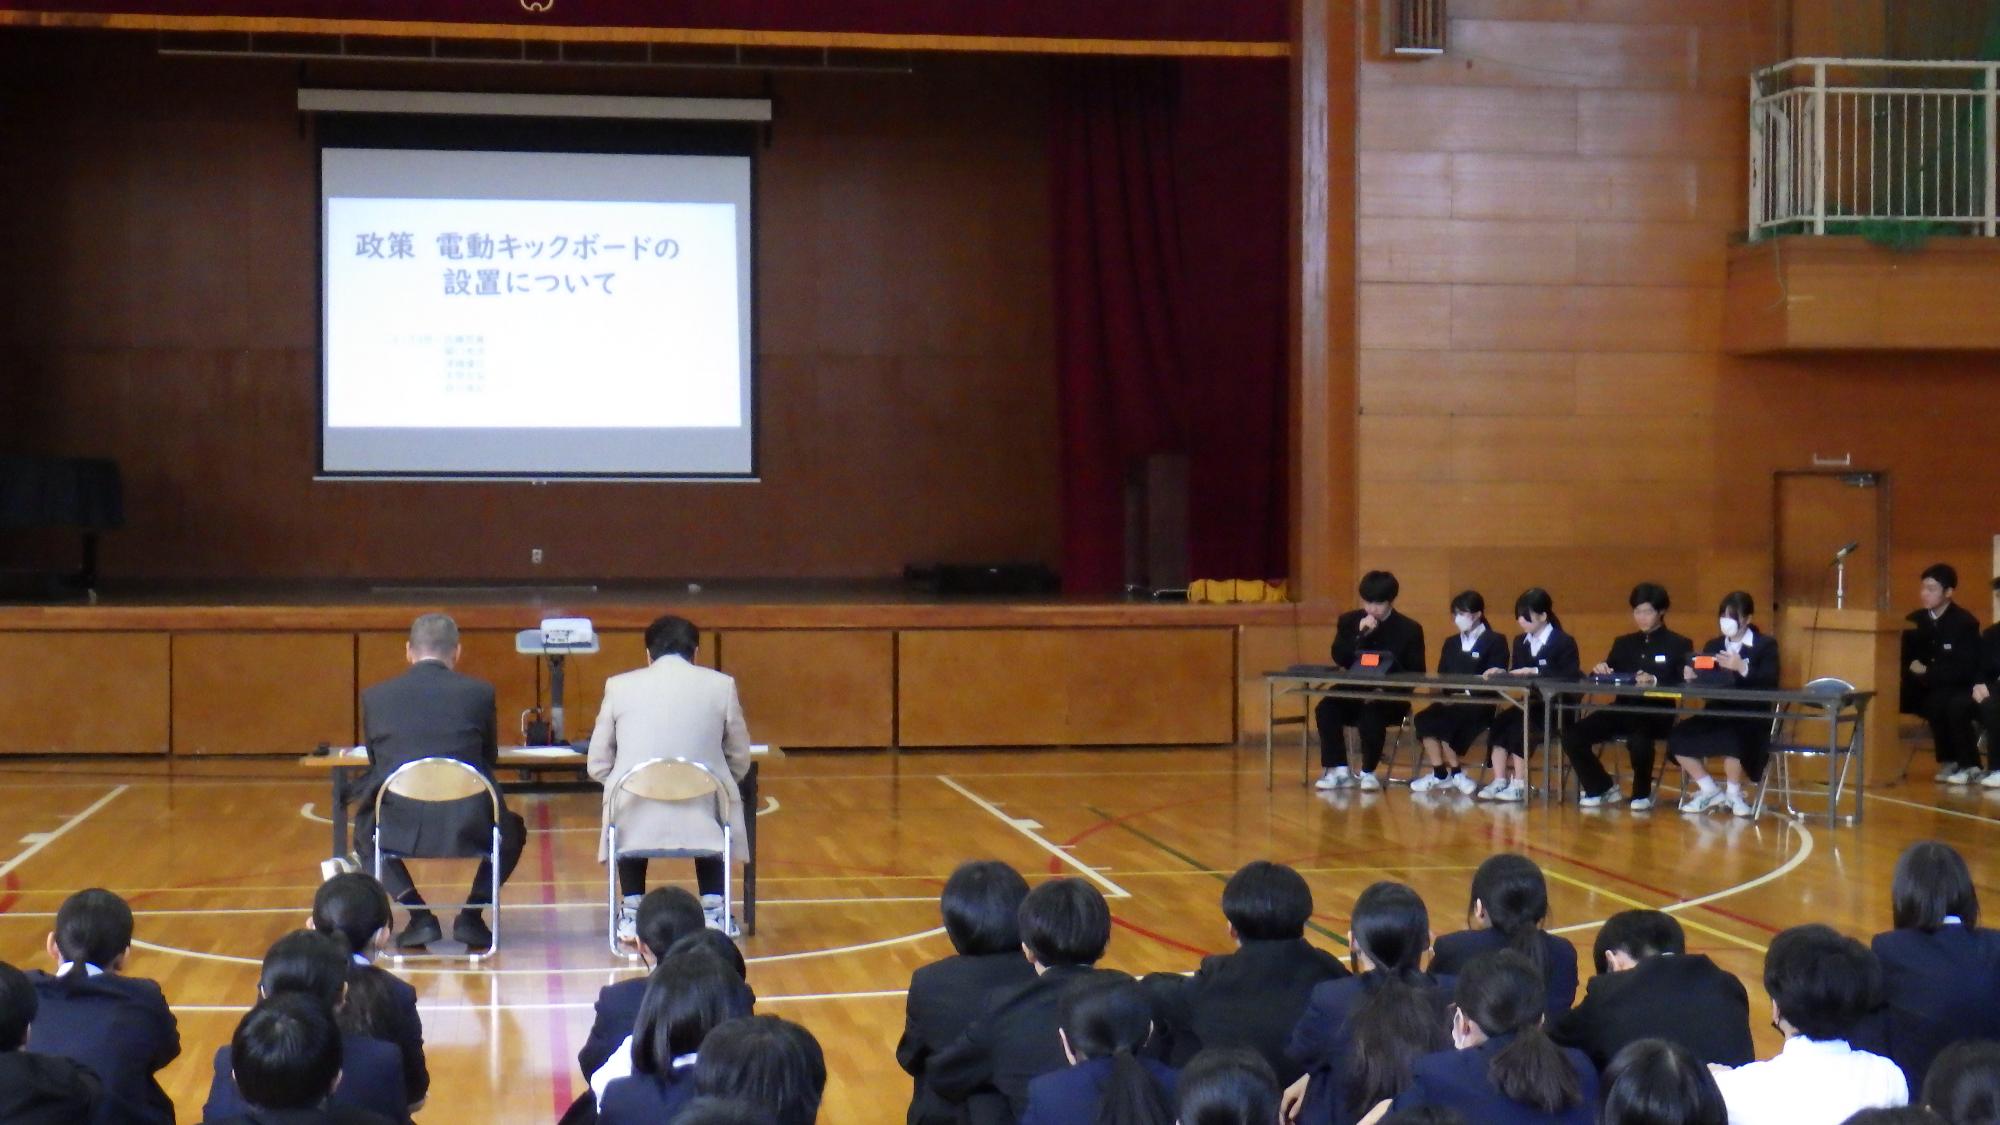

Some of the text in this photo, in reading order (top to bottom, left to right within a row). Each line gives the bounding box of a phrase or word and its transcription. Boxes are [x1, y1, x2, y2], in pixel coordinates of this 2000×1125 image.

[355, 231, 680, 261] 政策 電動キックボードの
[443, 268, 616, 296] 設置について
